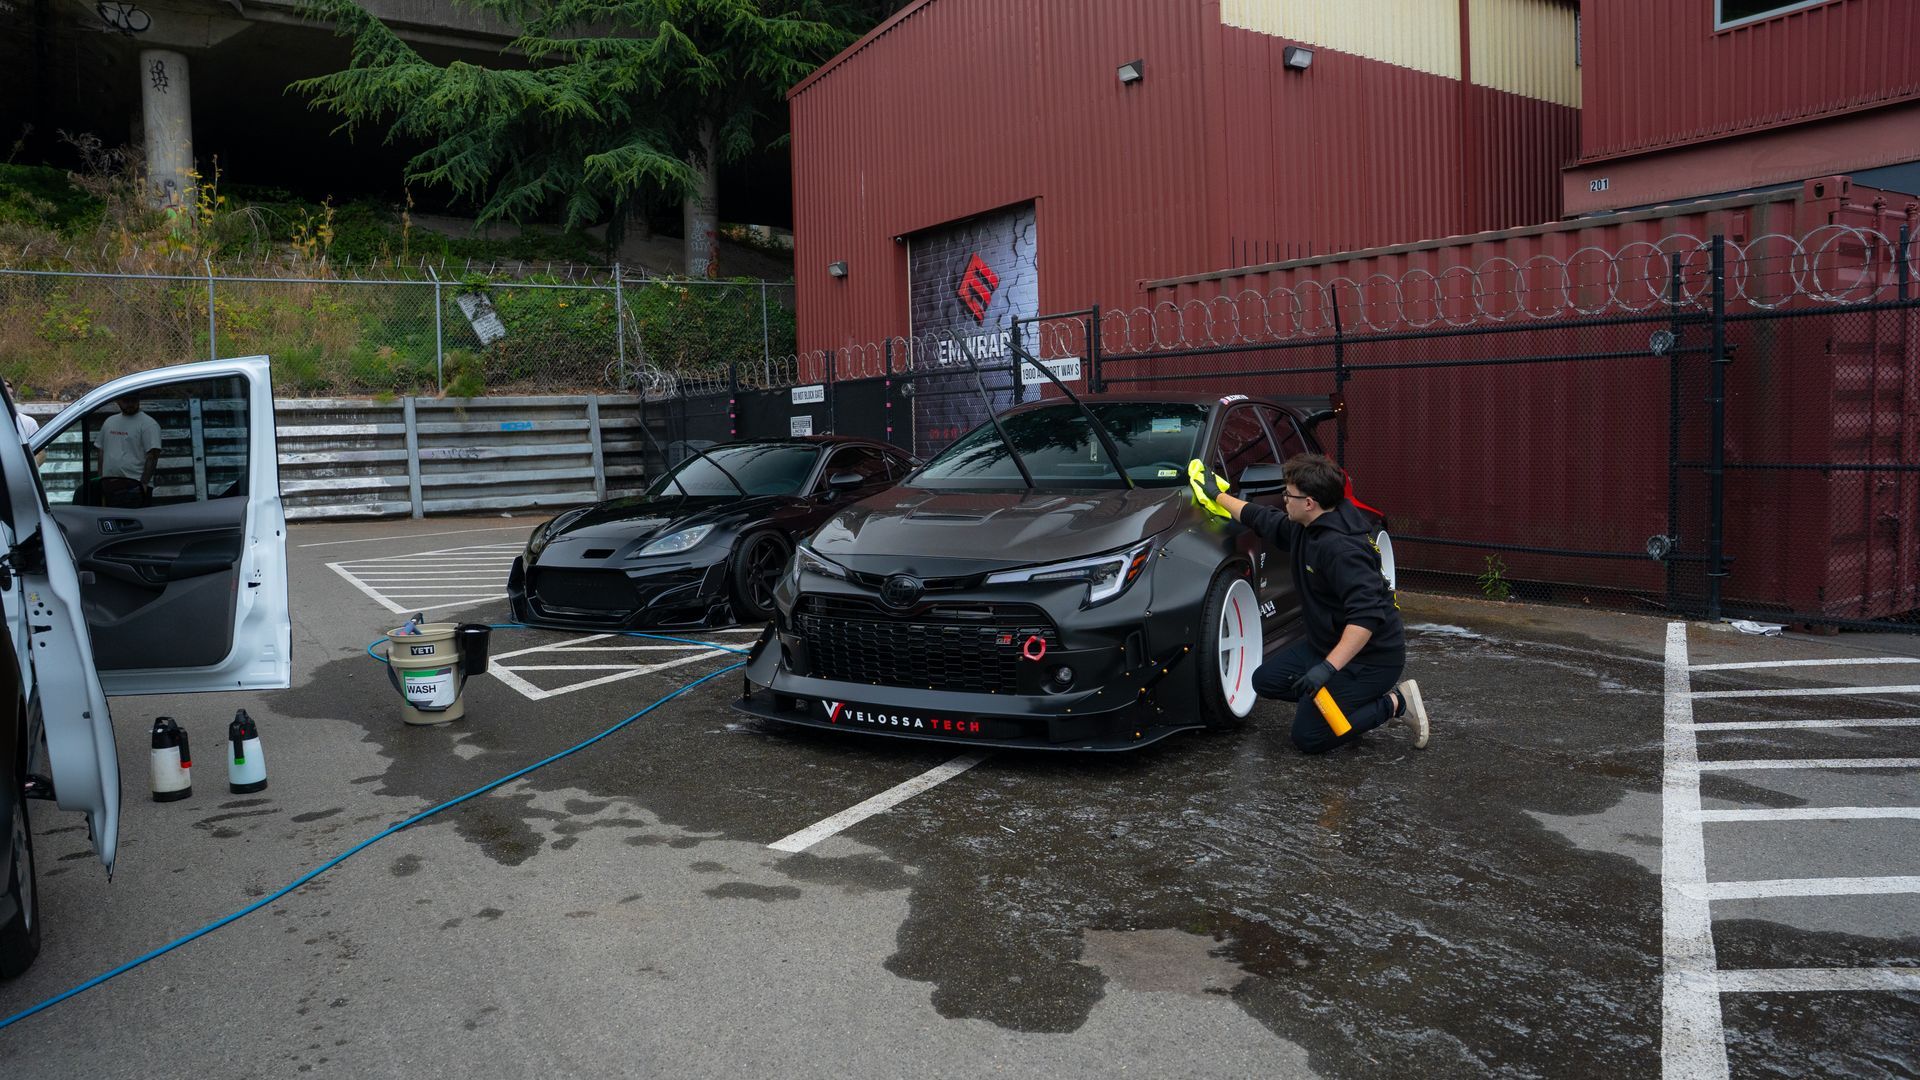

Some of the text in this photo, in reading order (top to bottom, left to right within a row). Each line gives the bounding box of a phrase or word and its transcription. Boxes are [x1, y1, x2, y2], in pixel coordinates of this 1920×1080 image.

[1591, 179, 1608, 191] 201
[1061, 364, 1074, 377] WAY
[1075, 363, 1080, 375] S
[411, 646, 433, 655] YETI
[406, 684, 437, 694] WASH
[844, 709, 980, 733] VELOSSA TECH
